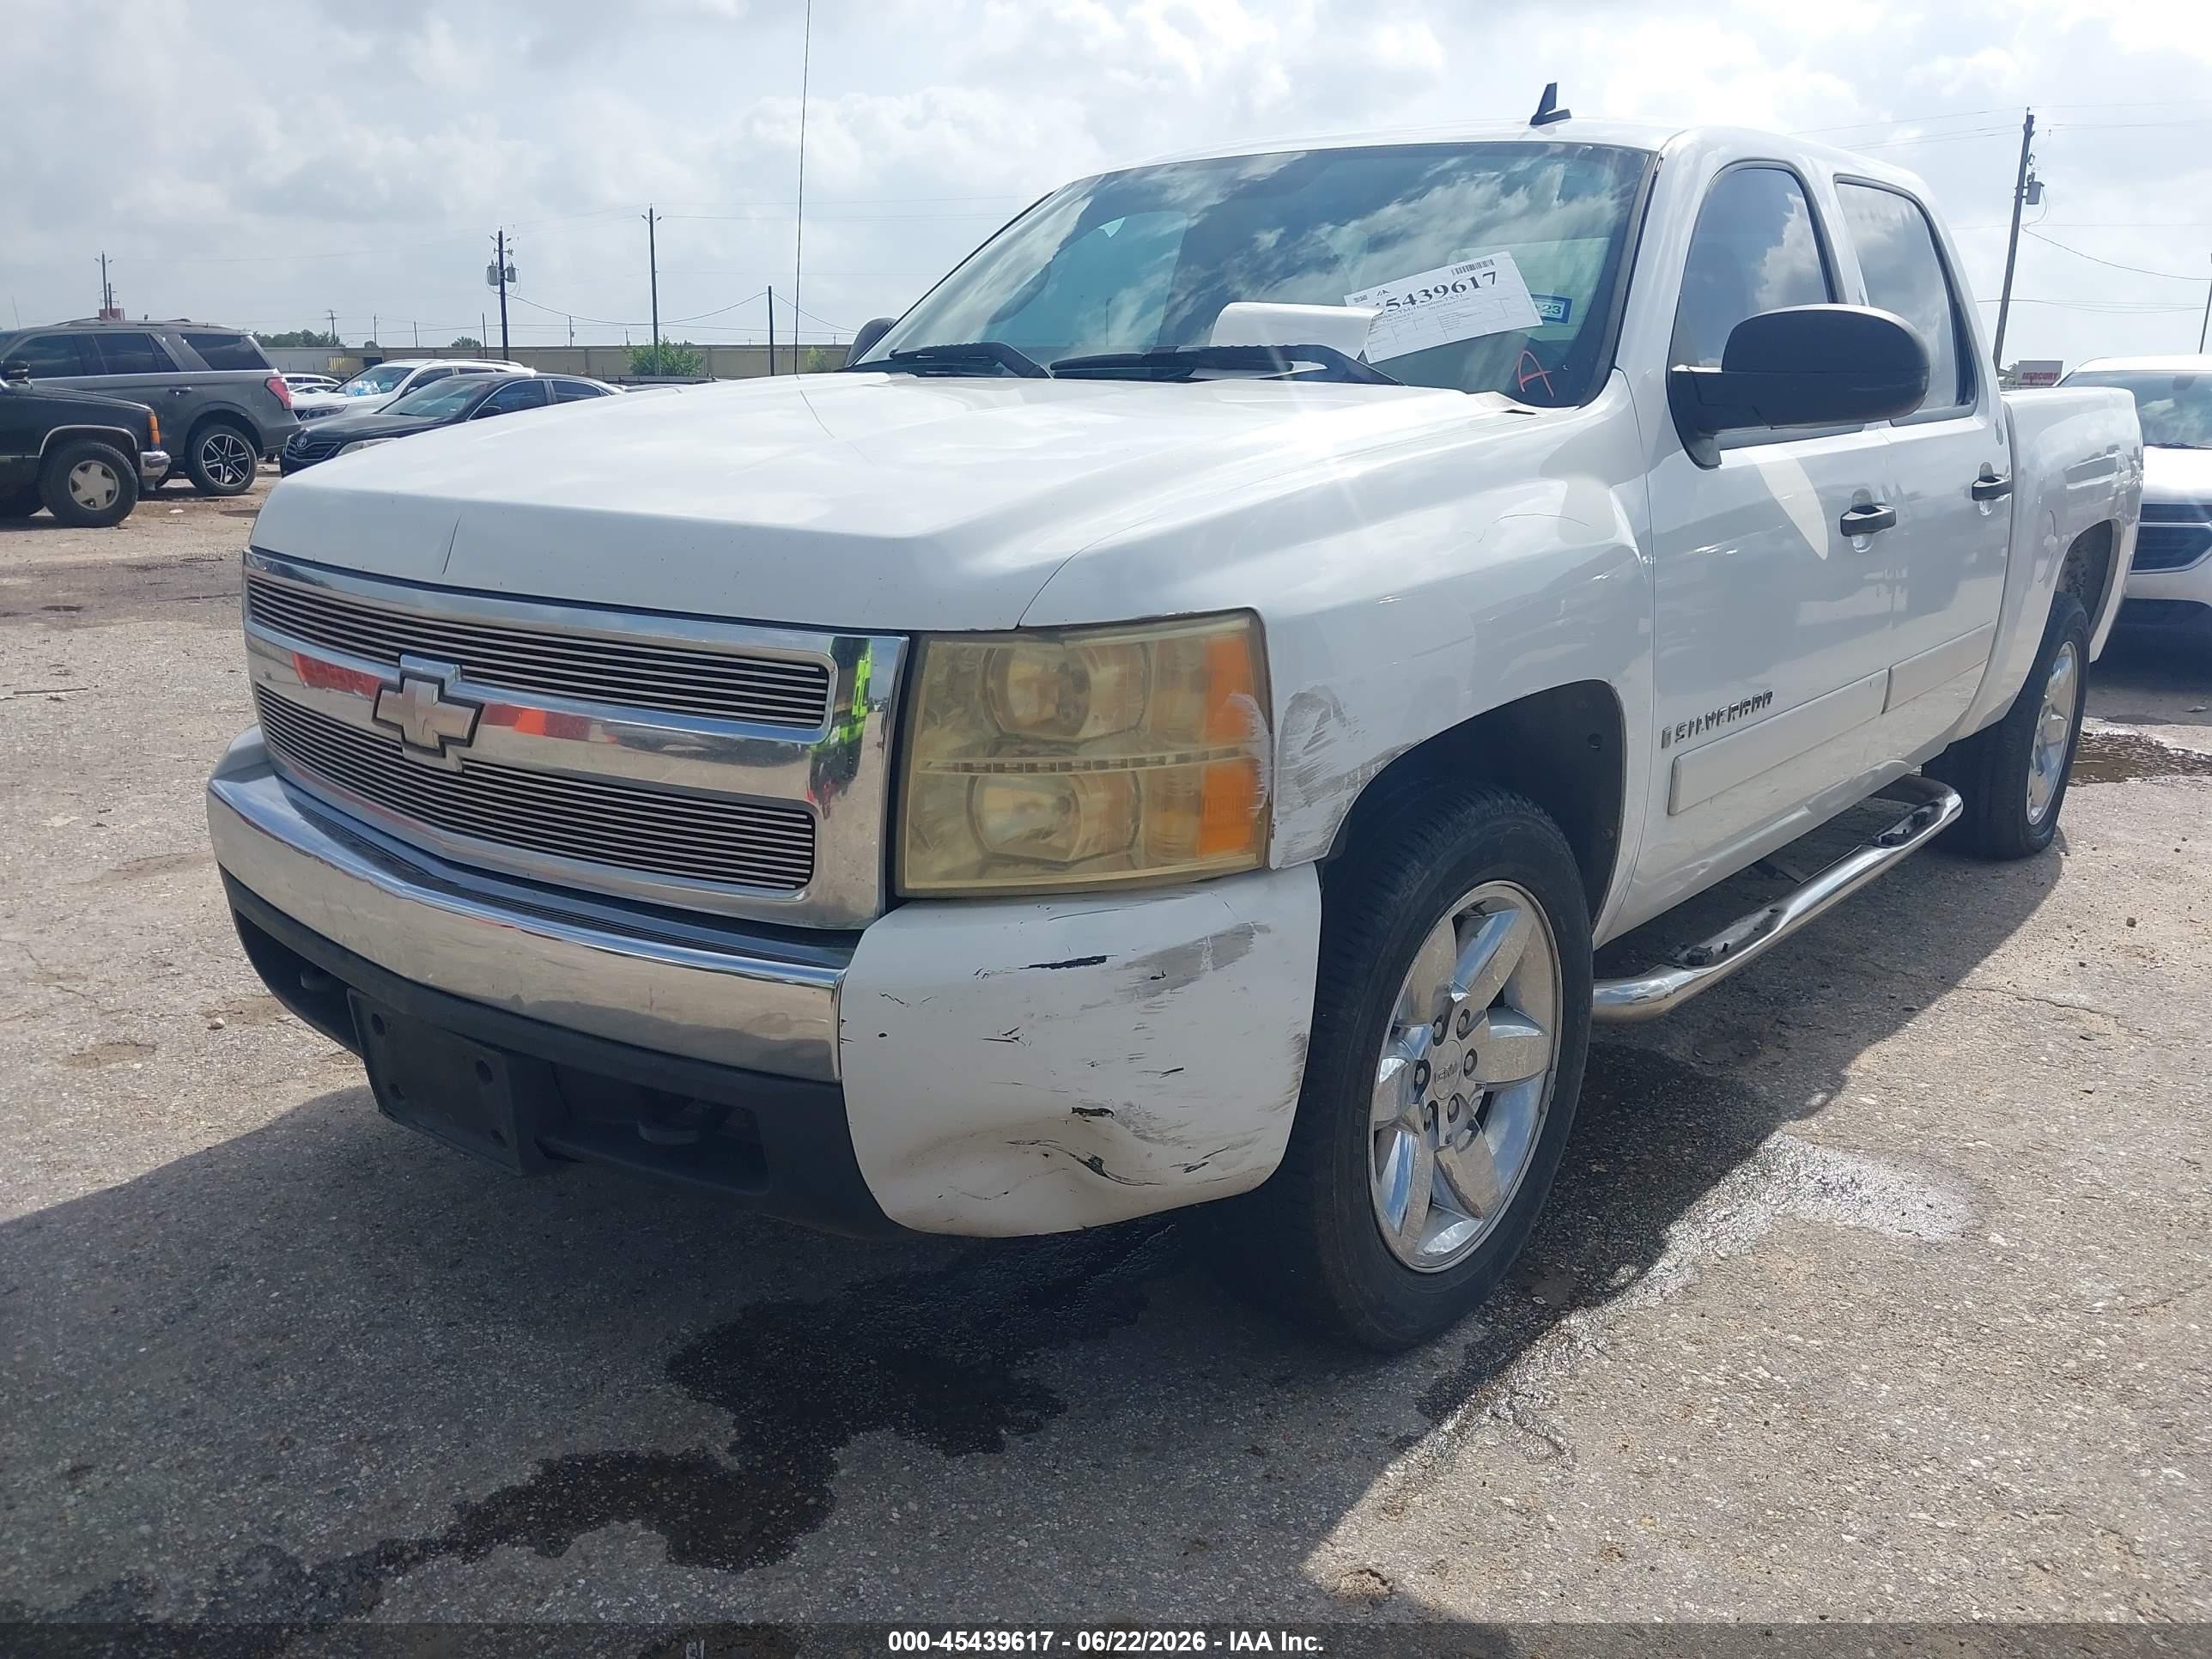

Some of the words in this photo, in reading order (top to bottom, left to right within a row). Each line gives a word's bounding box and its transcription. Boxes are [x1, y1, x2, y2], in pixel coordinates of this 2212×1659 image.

[1375, 270, 1496, 313] 5439617
[1542, 304, 1562, 314] 23
[1517, 350, 1554, 398] A
